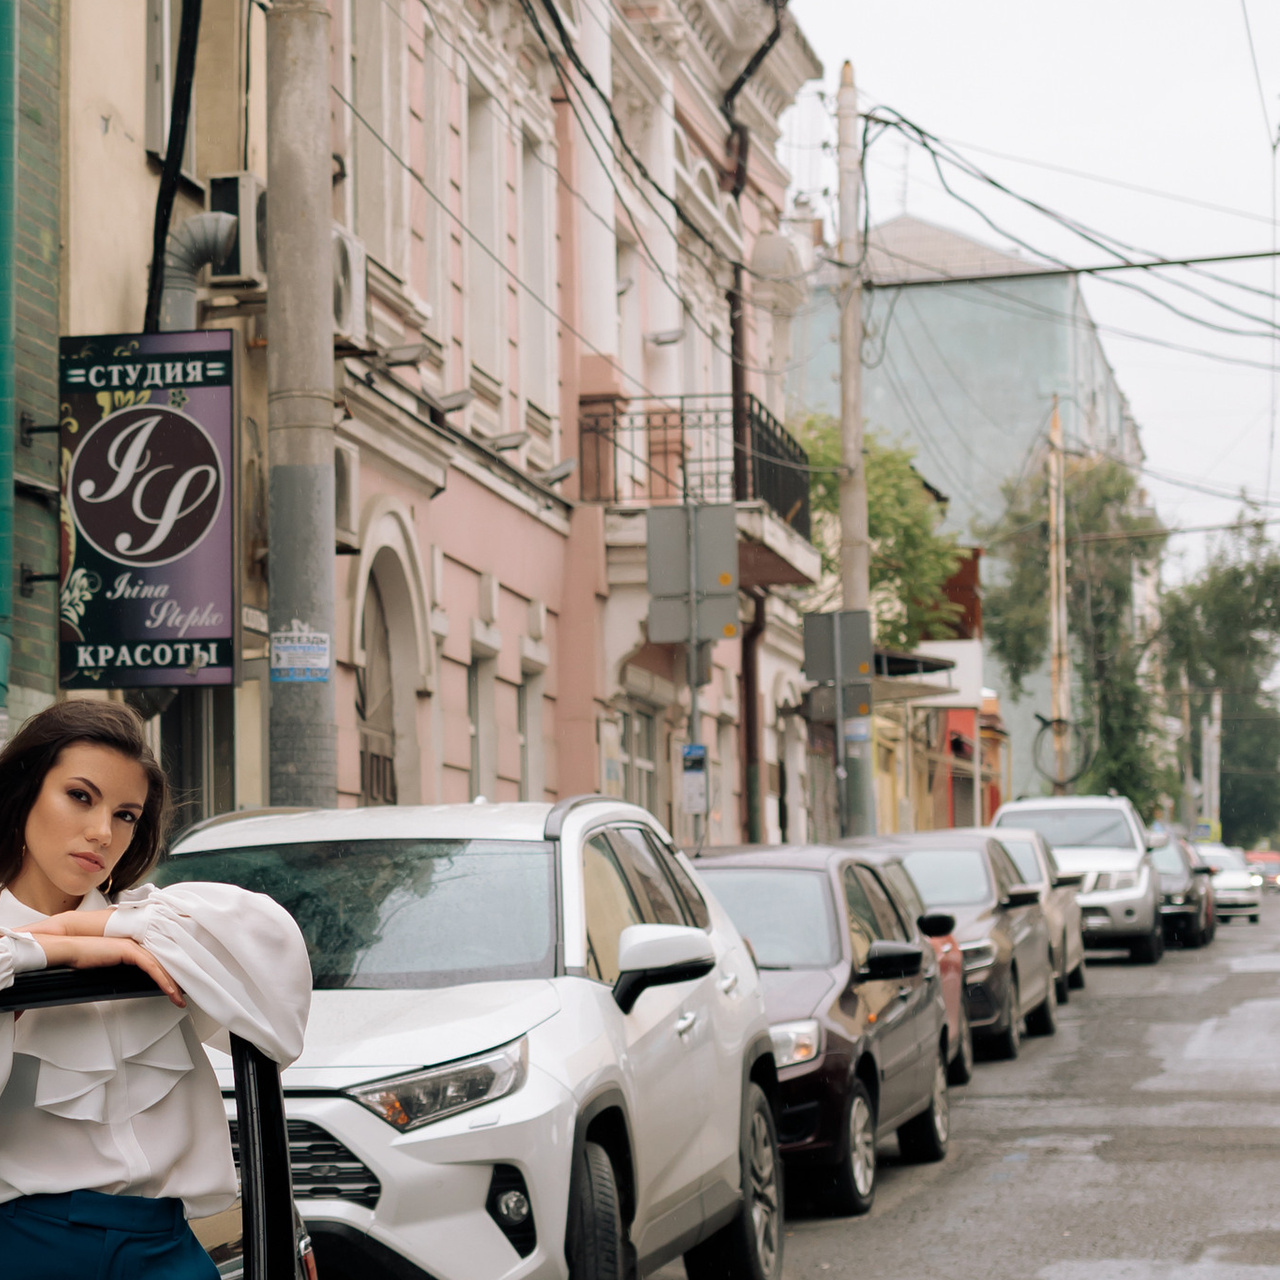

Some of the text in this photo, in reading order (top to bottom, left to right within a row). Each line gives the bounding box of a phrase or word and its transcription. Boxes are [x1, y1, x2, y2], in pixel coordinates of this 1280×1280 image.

[88, 361, 204, 388] СТУДИЯ
[105, 571, 170, 600] Irina
[76, 642, 219, 668] КРАСОТЫ
